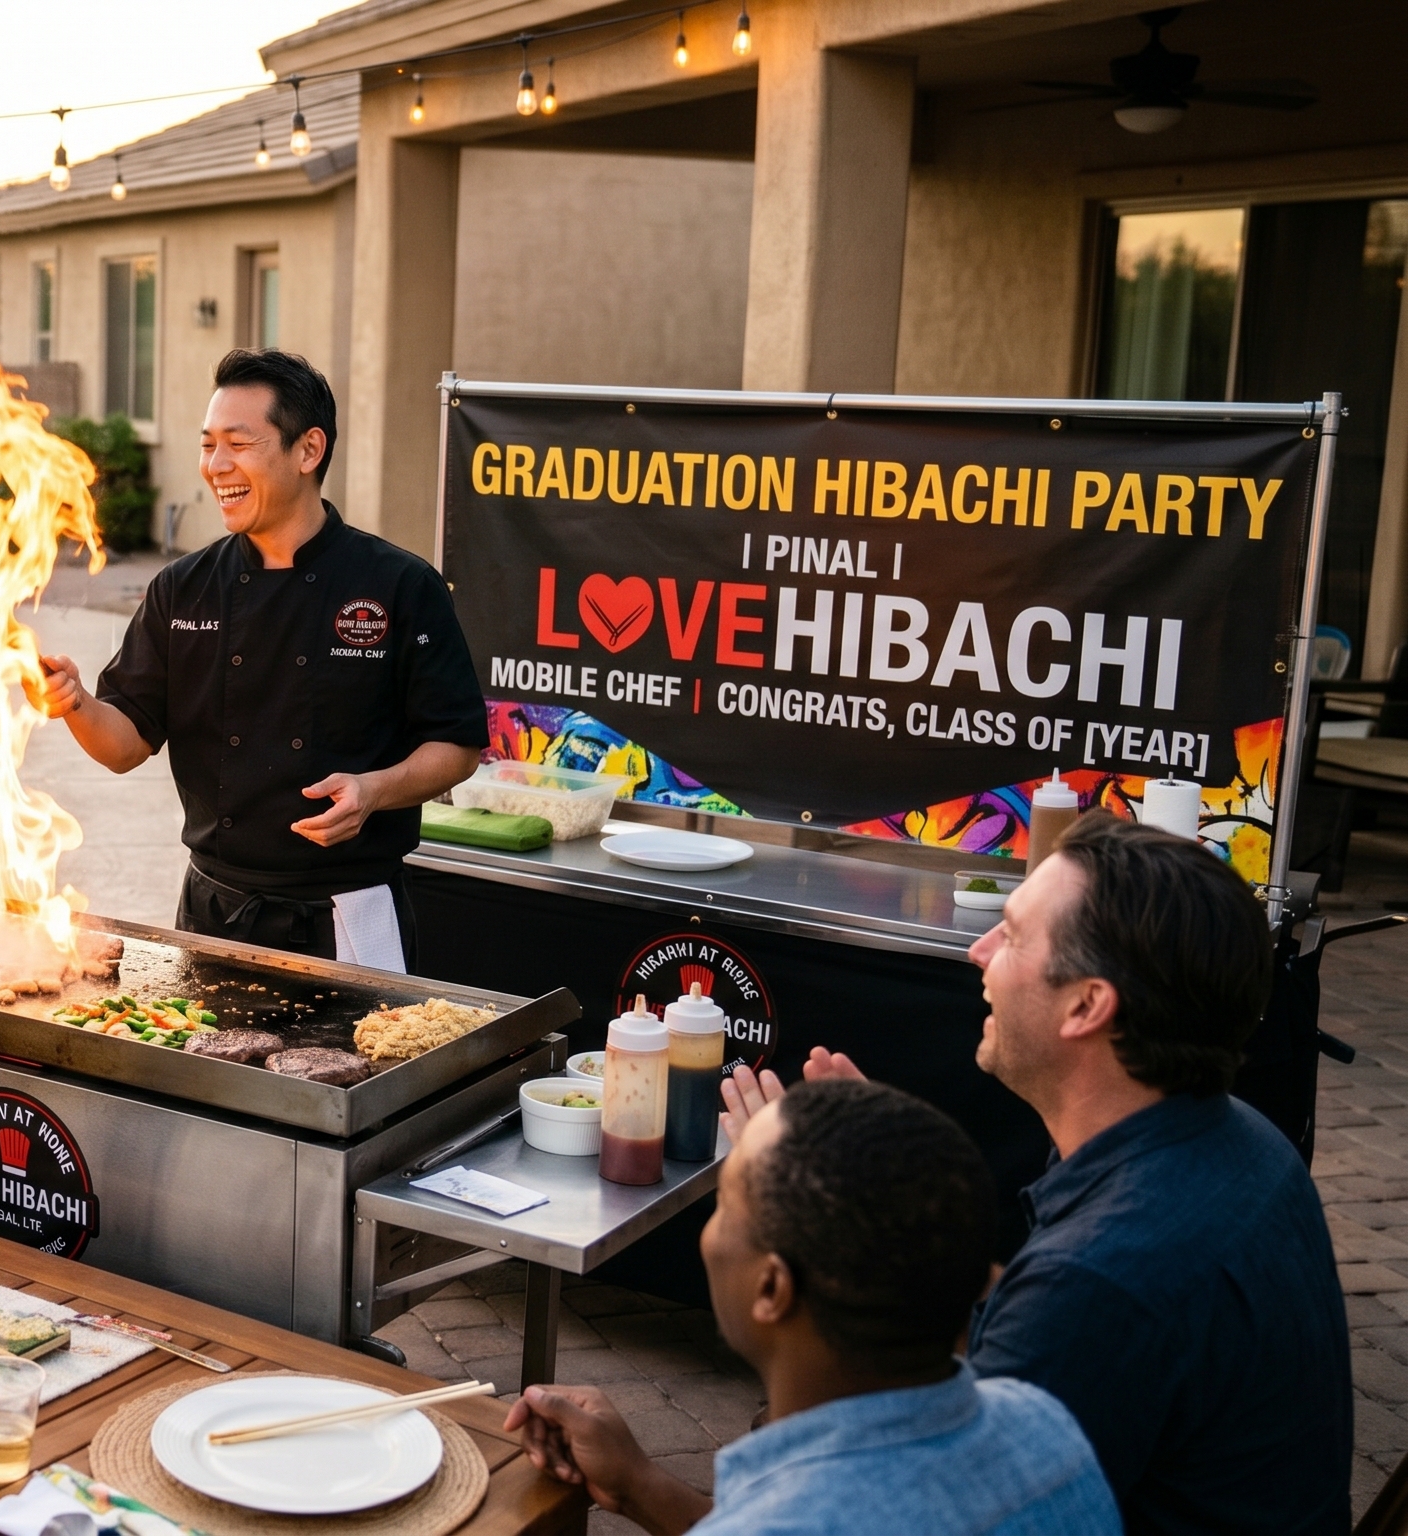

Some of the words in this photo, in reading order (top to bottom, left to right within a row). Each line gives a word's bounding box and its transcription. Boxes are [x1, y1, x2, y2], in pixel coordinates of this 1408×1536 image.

[471, 442, 796, 513] GRADUATION
[813, 458, 1051, 528] HIBACHI
[1070, 470, 1284, 540] PARTY
[765, 534, 878, 579] PINAL
[490, 656, 598, 698] MOBILE
[606, 669, 682, 707] CHEF
[717, 681, 895, 739] CONGRATS,
[905, 702, 1016, 746] CLASS
[1027, 715, 1074, 752] OF
[1083, 721, 1210, 778] [YEAR]
[698, 945, 719, 962] AT
[13, 1106, 35, 1127] AT
[1, 1177, 87, 1226] HIBACHI
